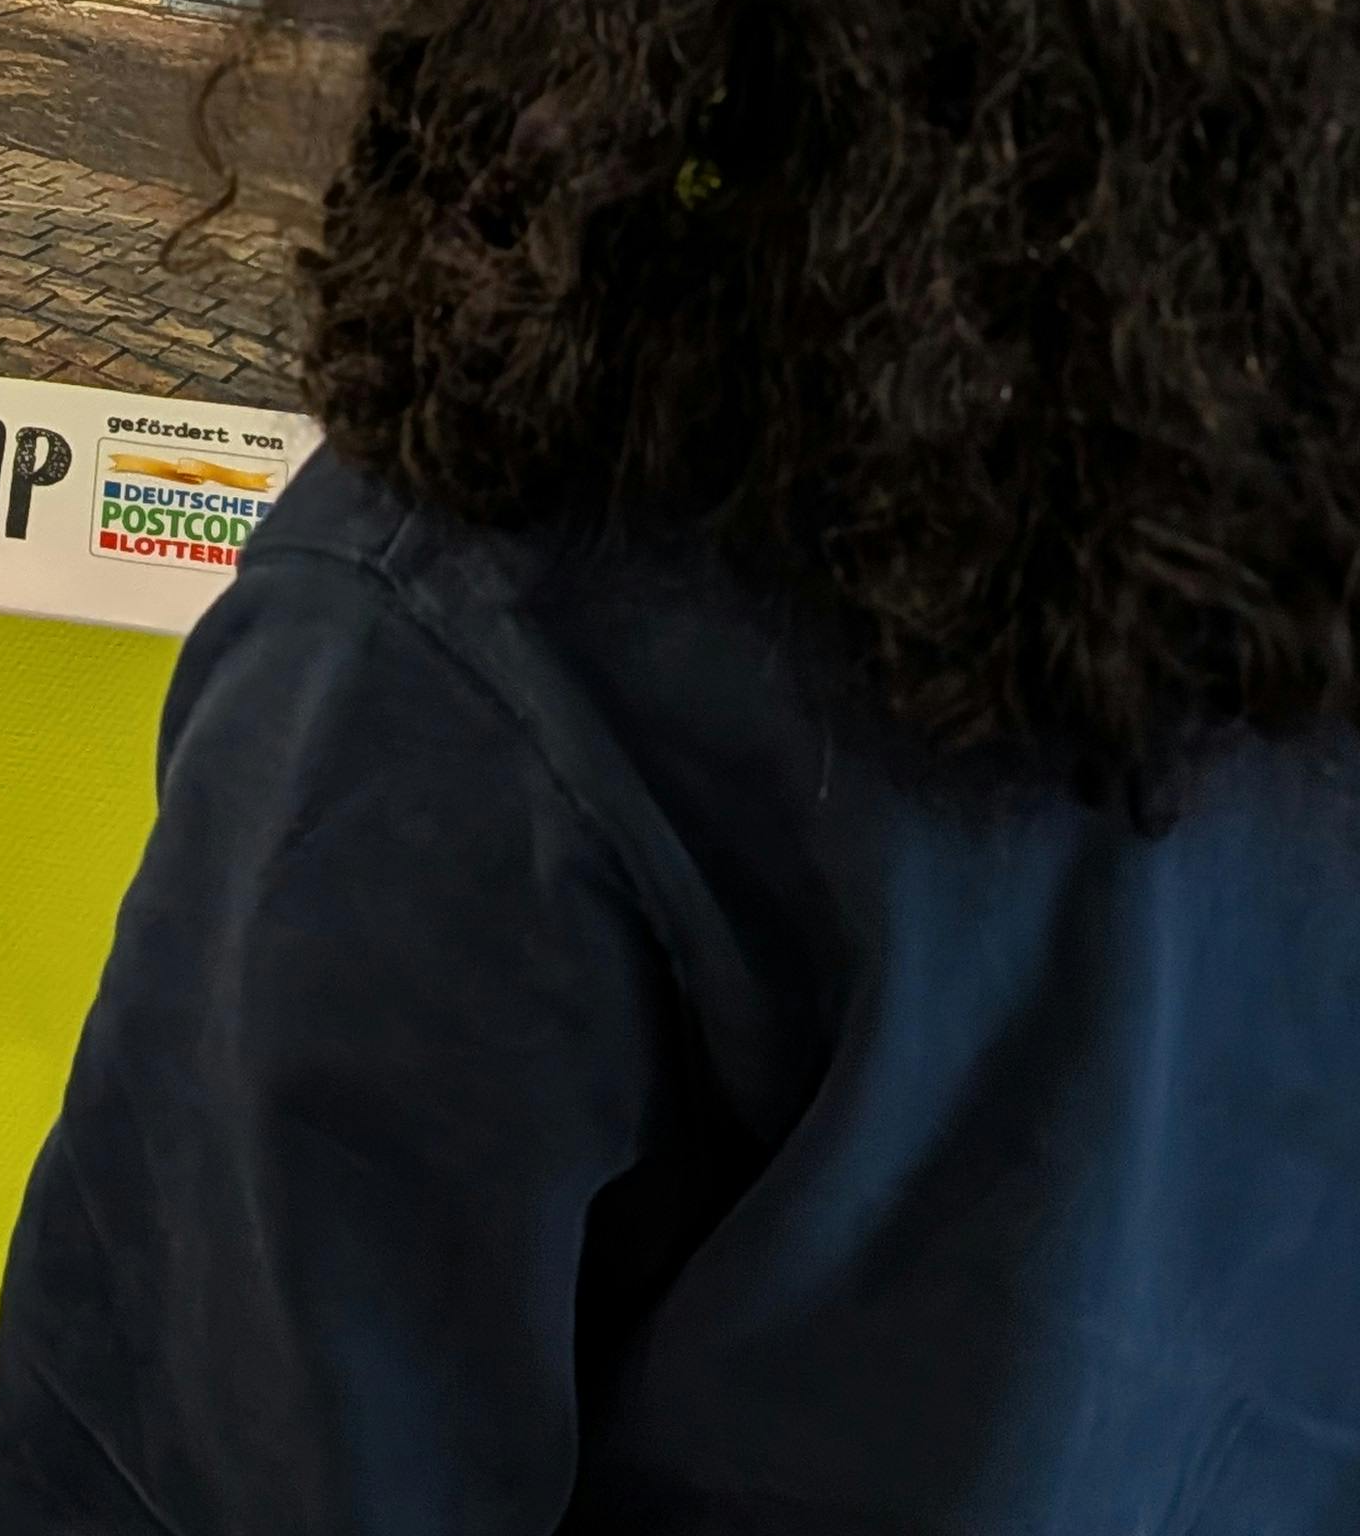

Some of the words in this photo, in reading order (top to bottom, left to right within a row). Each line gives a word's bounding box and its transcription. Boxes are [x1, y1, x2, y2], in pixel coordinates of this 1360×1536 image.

[107, 415, 230, 444] gefördert
[241, 432, 284, 450] von
[124, 484, 254, 517] DEUTSCHE
[101, 500, 257, 546] POSTCOD
[120, 534, 238, 566] LOTTERI
